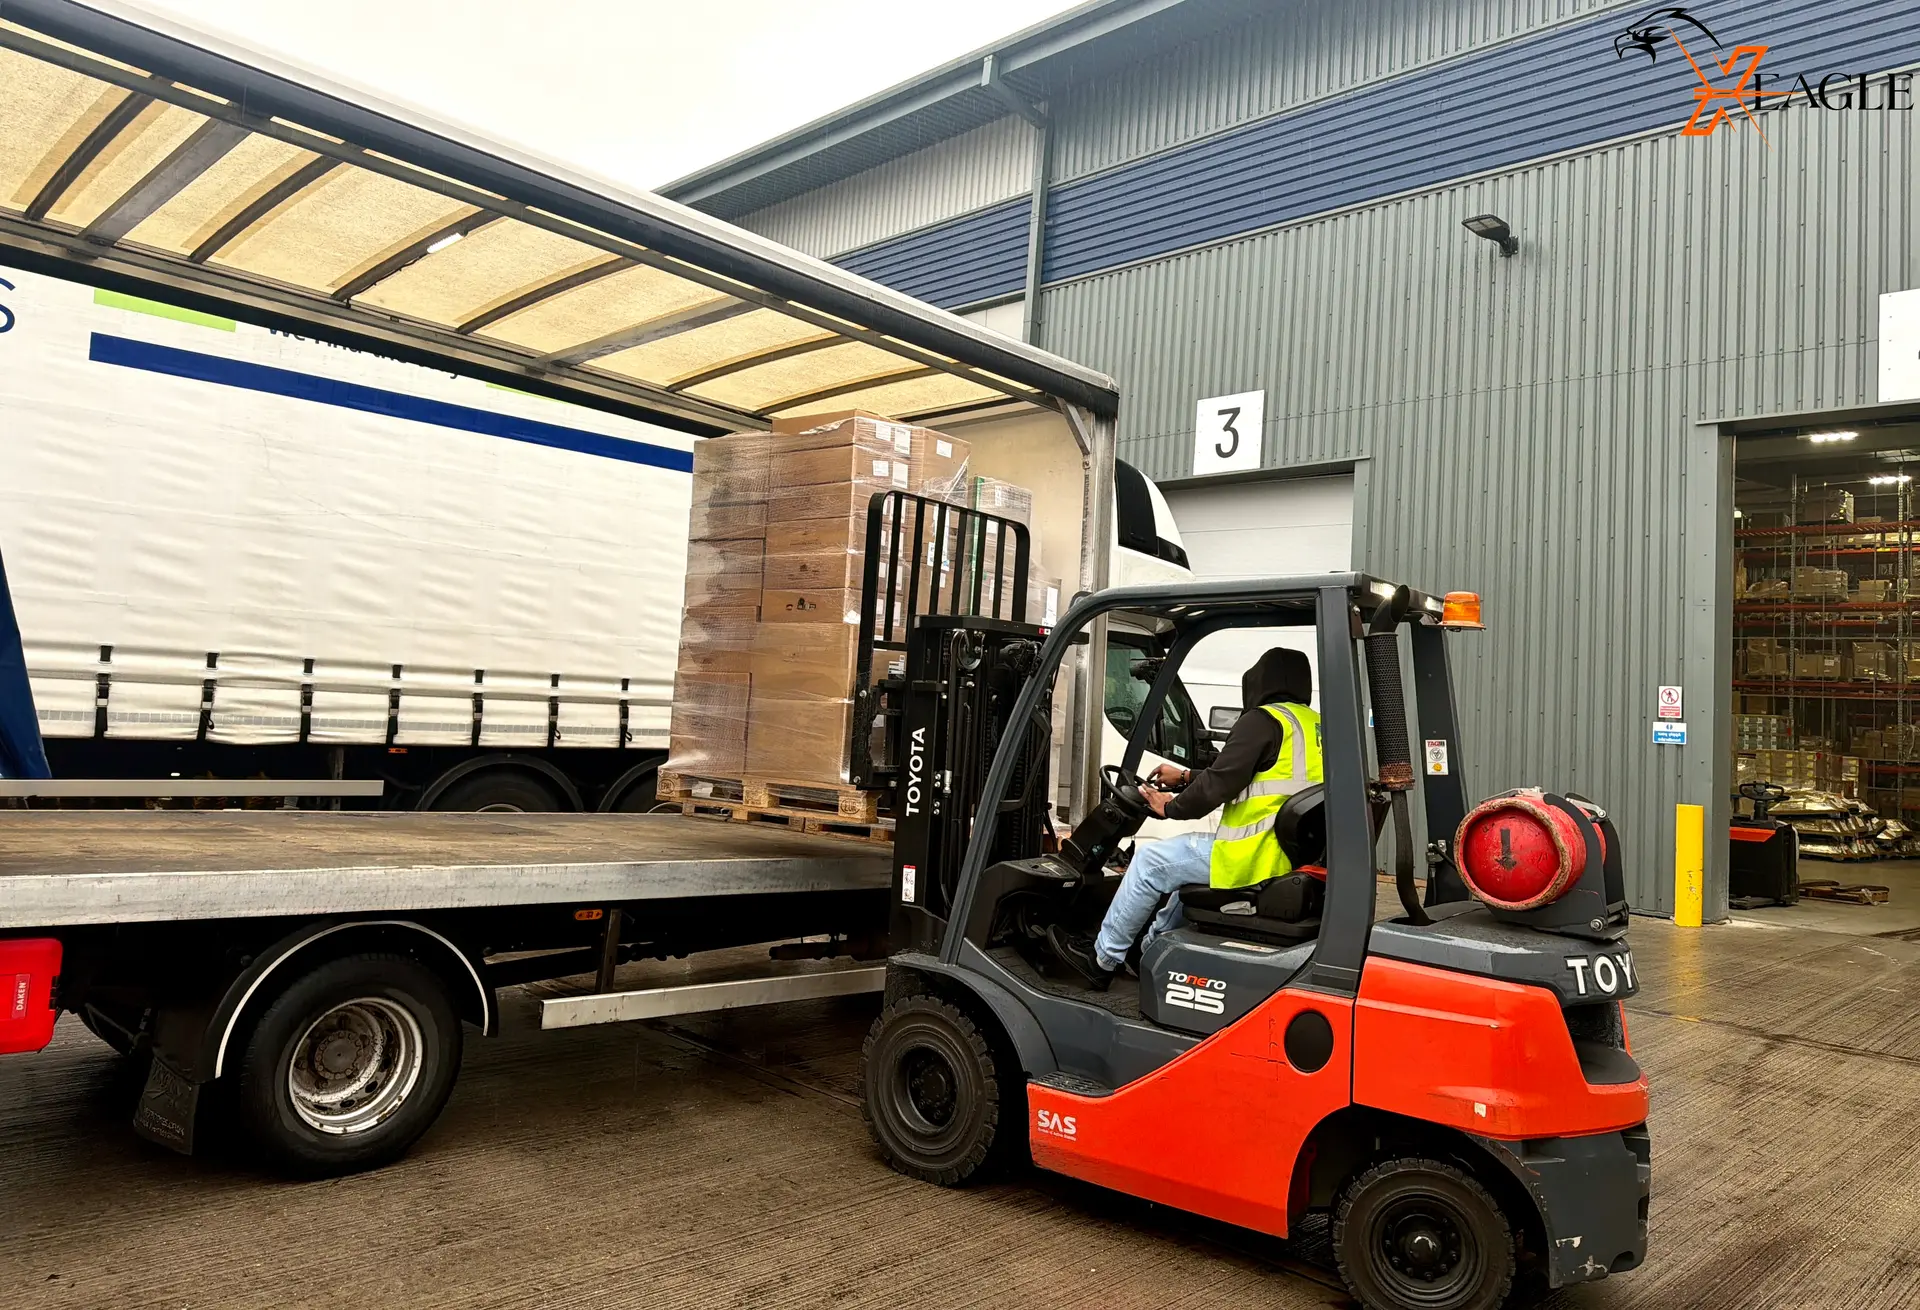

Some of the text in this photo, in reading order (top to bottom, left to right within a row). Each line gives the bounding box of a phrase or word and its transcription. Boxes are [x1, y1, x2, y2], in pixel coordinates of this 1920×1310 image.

[1215, 407, 1241, 458] 3
[906, 727, 926, 817] TOYOTA
[1566, 951, 1638, 994] TOY
[15, 982, 27, 1011] DAKEN
[1165, 983, 1225, 1015] 25
[1037, 1109, 1077, 1135] SAS
